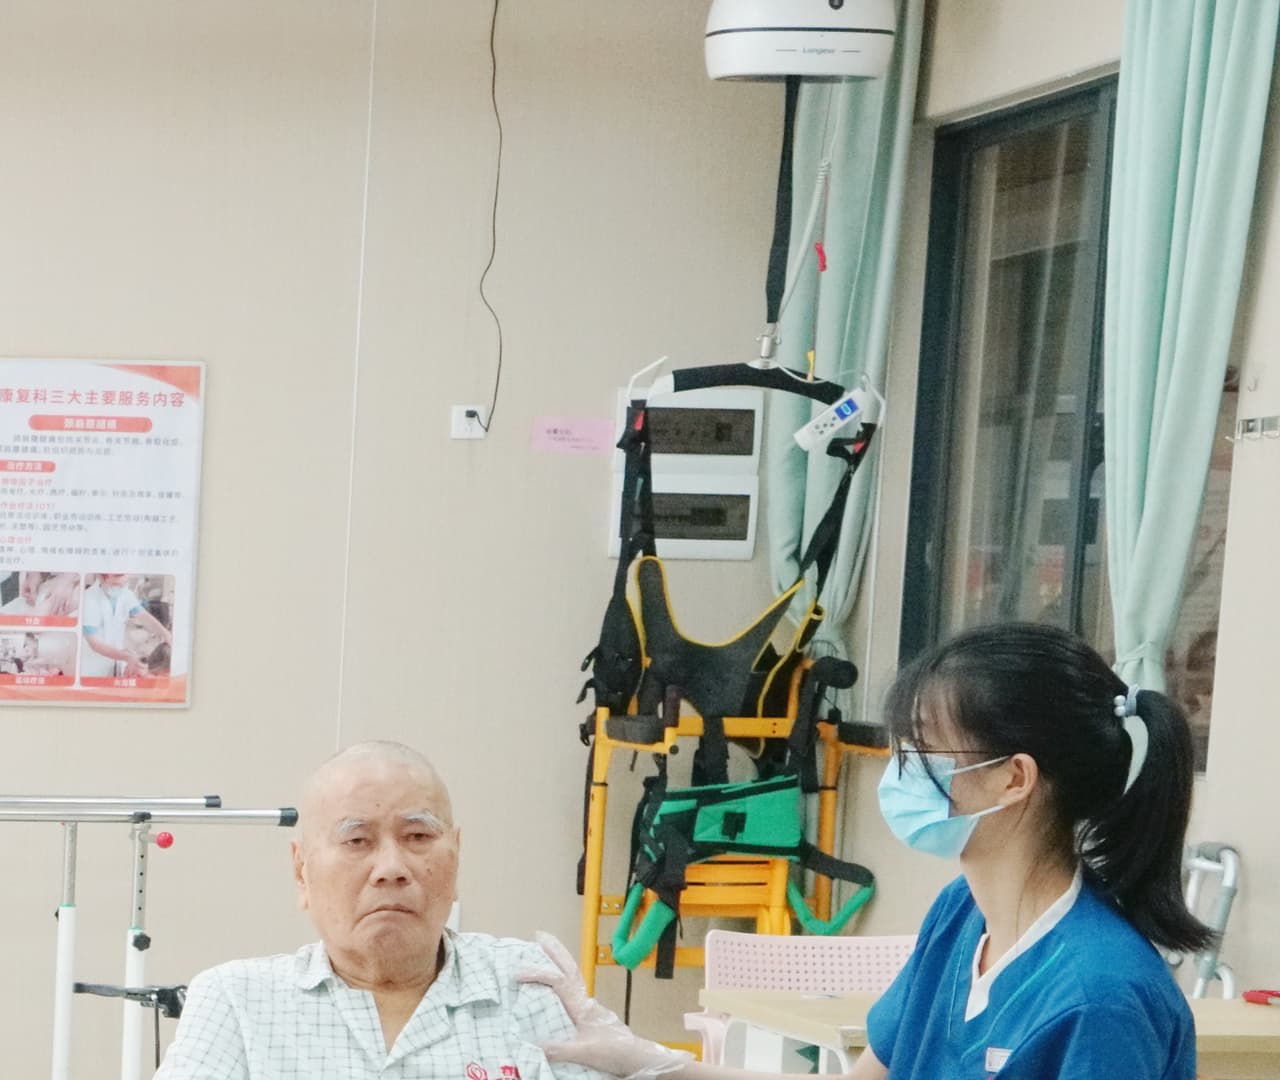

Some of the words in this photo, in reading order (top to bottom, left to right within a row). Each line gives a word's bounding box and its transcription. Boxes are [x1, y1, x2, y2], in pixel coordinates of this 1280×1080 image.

[0, 388, 185, 407] 康复科三大主要服务内容
